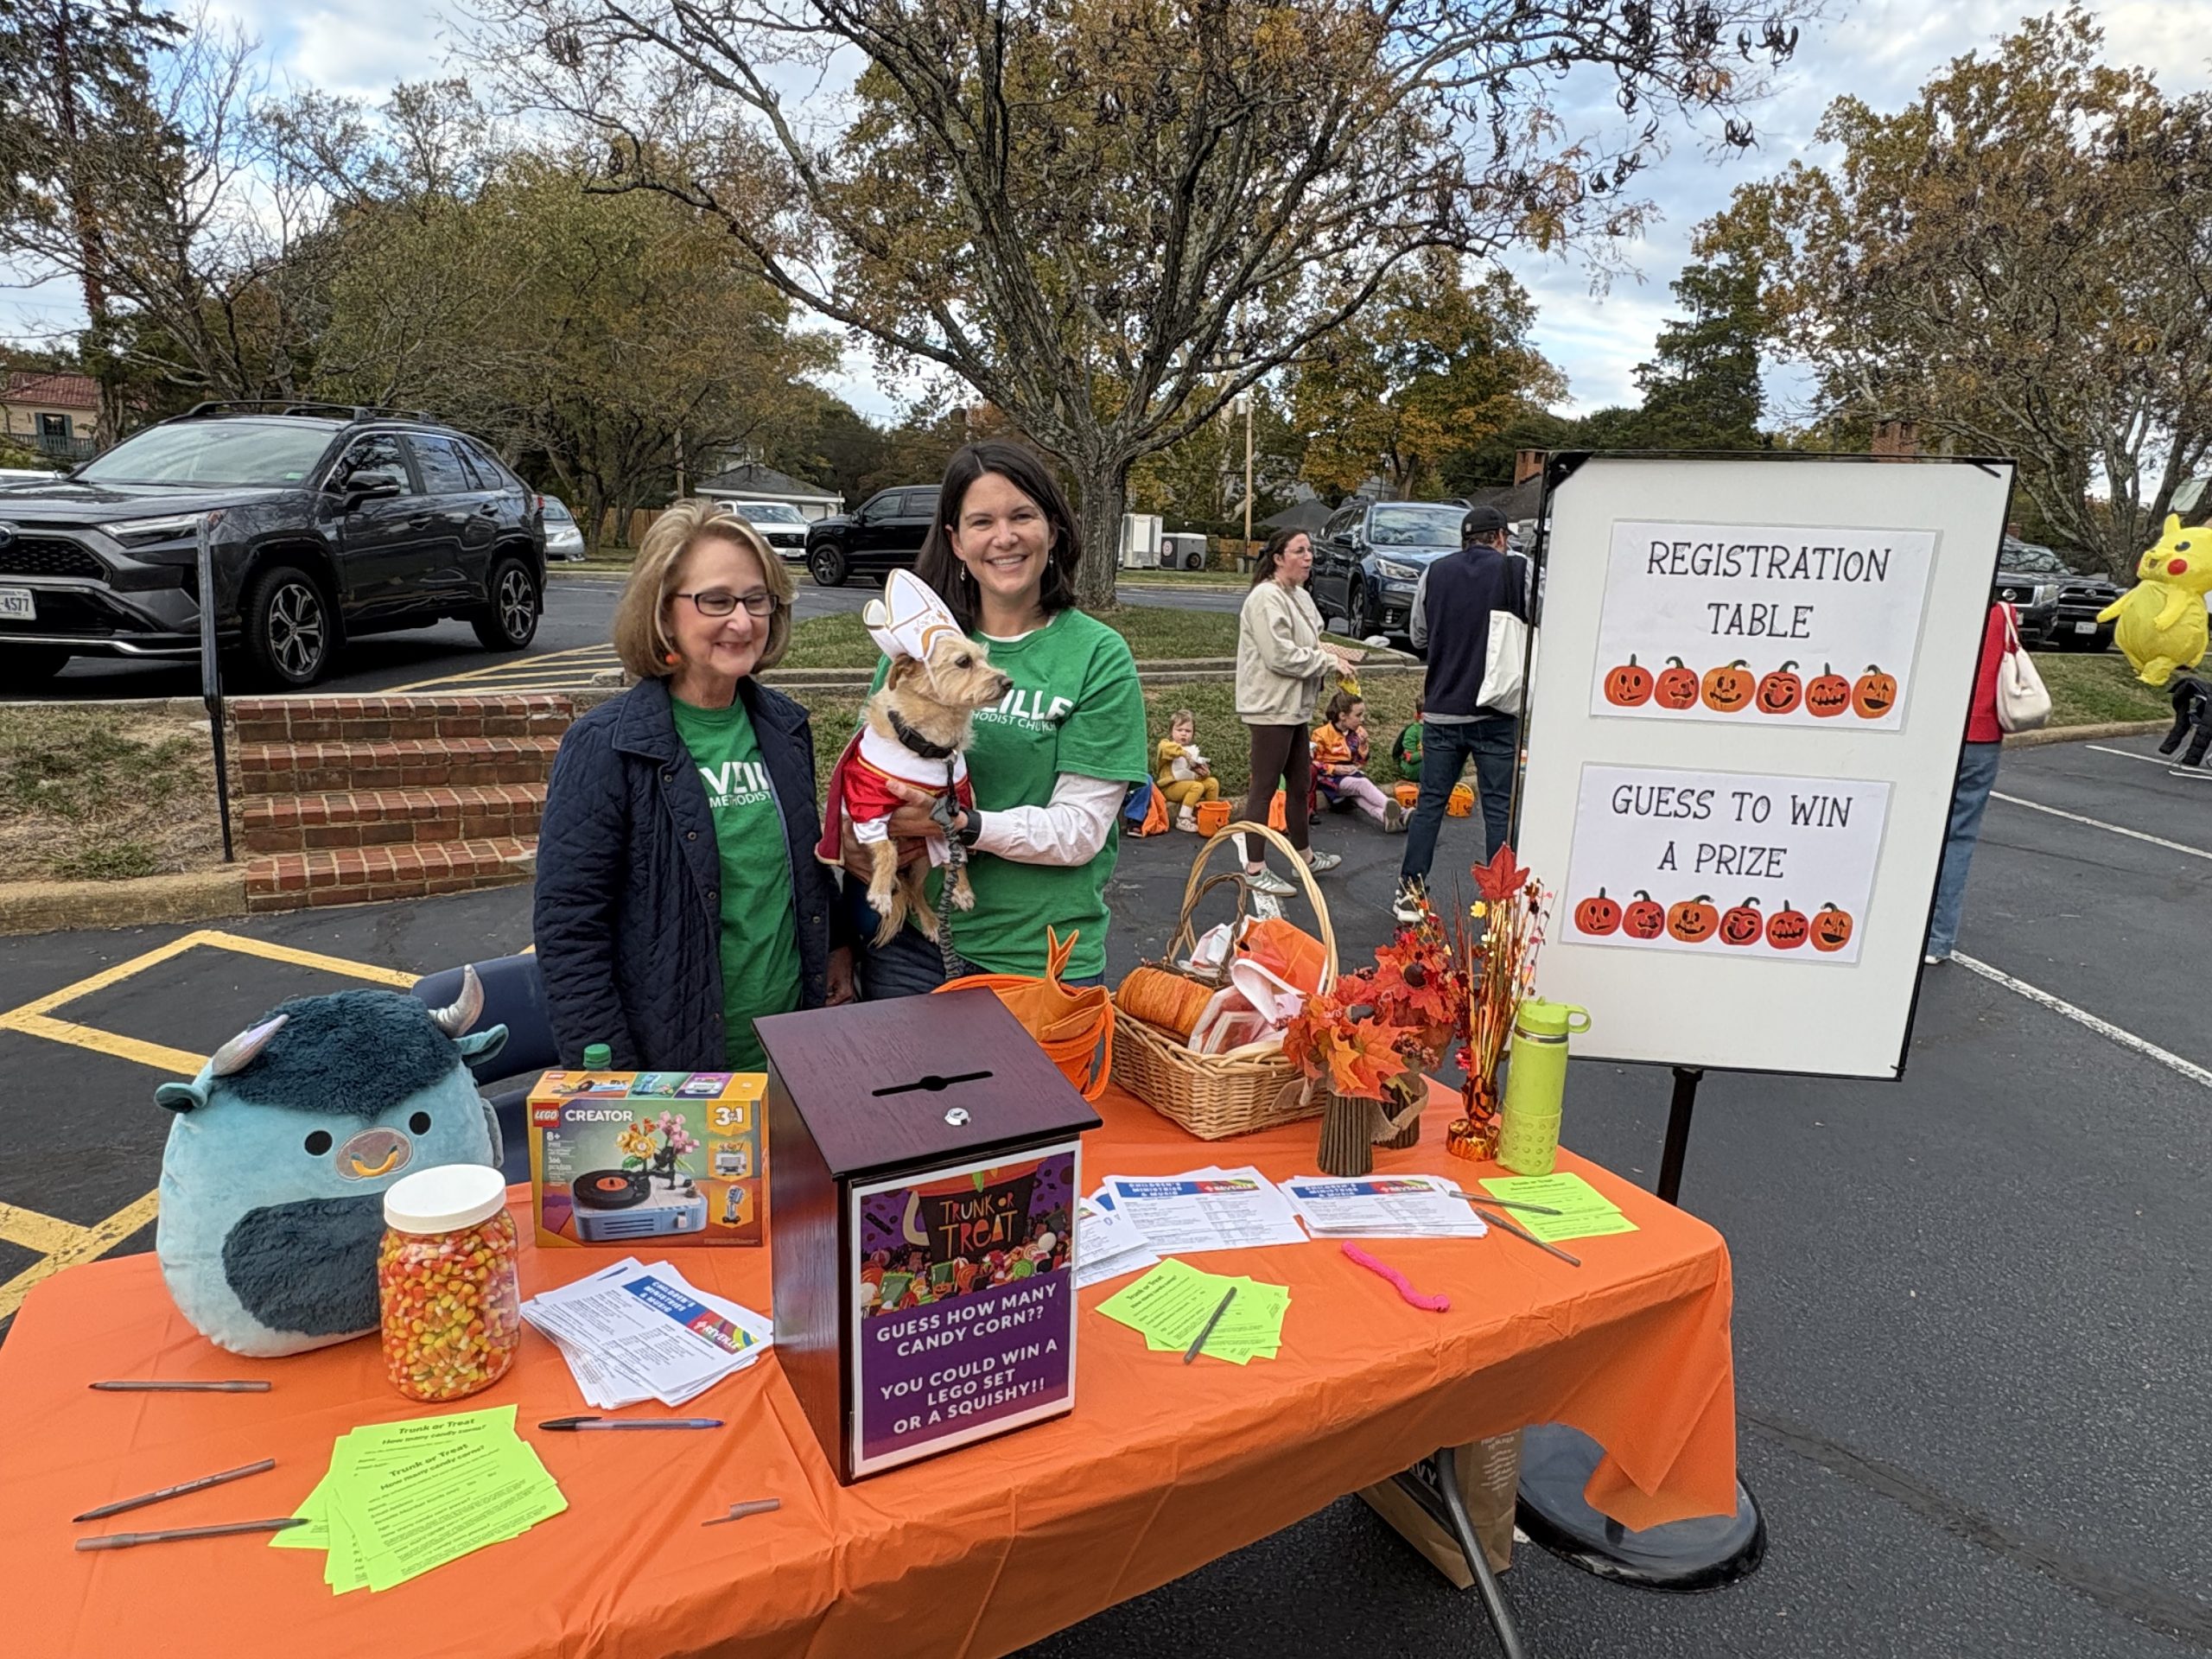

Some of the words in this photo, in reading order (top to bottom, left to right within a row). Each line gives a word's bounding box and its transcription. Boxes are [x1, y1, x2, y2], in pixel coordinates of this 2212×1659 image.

[1646, 541, 1891, 582] REGISTRATION
[1707, 603, 1814, 639] TABLE
[982, 690, 1073, 721] ILLE
[1612, 785, 1714, 819] GUESS
[1732, 791, 1770, 823] TO
[1791, 795, 1853, 828] WIN
[1657, 842, 1677, 871] A
[1694, 843, 1787, 878] PRIZE
[534, 1109, 559, 1121] LEGO
[565, 1109, 632, 1122] CREATOR
[546, 1131, 560, 1141] 8+
[939, 1193, 995, 1224] TRUNK
[877, 1314, 939, 1342] GUESS
[947, 1300, 995, 1325] HOW
[1001, 1282, 1057, 1311] MANY
[897, 1327, 968, 1357] CANDY
[973, 1306, 1045, 1337] CORN??
[880, 1377, 923, 1401] YOU
[929, 1357, 995, 1387] COULD
[1001, 1344, 1039, 1365] WIN
[1046, 1339, 1058, 1351] A
[927, 1381, 977, 1406] LEGO
[983, 1369, 1015, 1389] SET
[893, 1416, 922, 1433] OR
[928, 1410, 941, 1425] A
[948, 1377, 1045, 1419] SQUISHY!!
[398, 1426, 429, 1434] Trunk
[447, 1419, 474, 1427] Treat
[431, 1430, 456, 1439] candy
[380, 1478, 402, 1491] How
[404, 1469, 428, 1481] many
[429, 1459, 456, 1471] candy
[457, 1445, 485, 1459] corns?
[389, 1460, 423, 1477] Trunk
[438, 1443, 468, 1457] Treat
